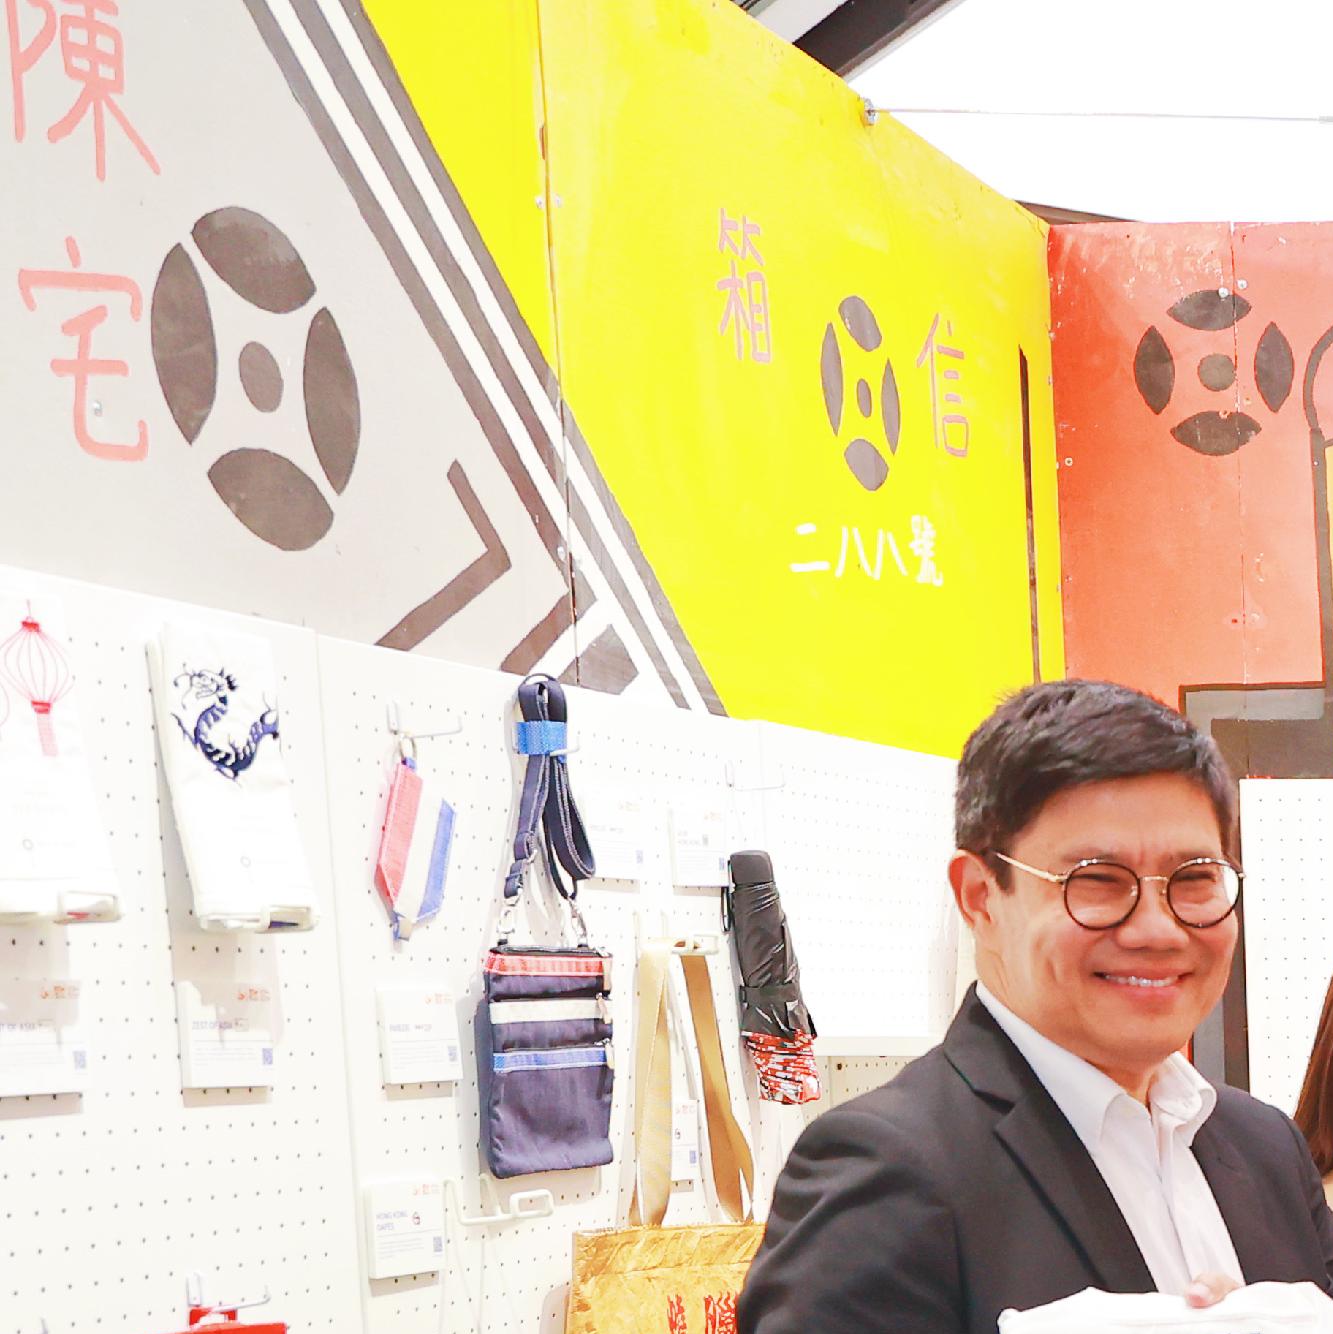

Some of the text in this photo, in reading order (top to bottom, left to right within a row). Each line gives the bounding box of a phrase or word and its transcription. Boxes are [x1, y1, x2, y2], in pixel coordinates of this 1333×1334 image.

[716, 207, 970, 459] 箱 信
[788, 514, 944, 588] 二八八號
